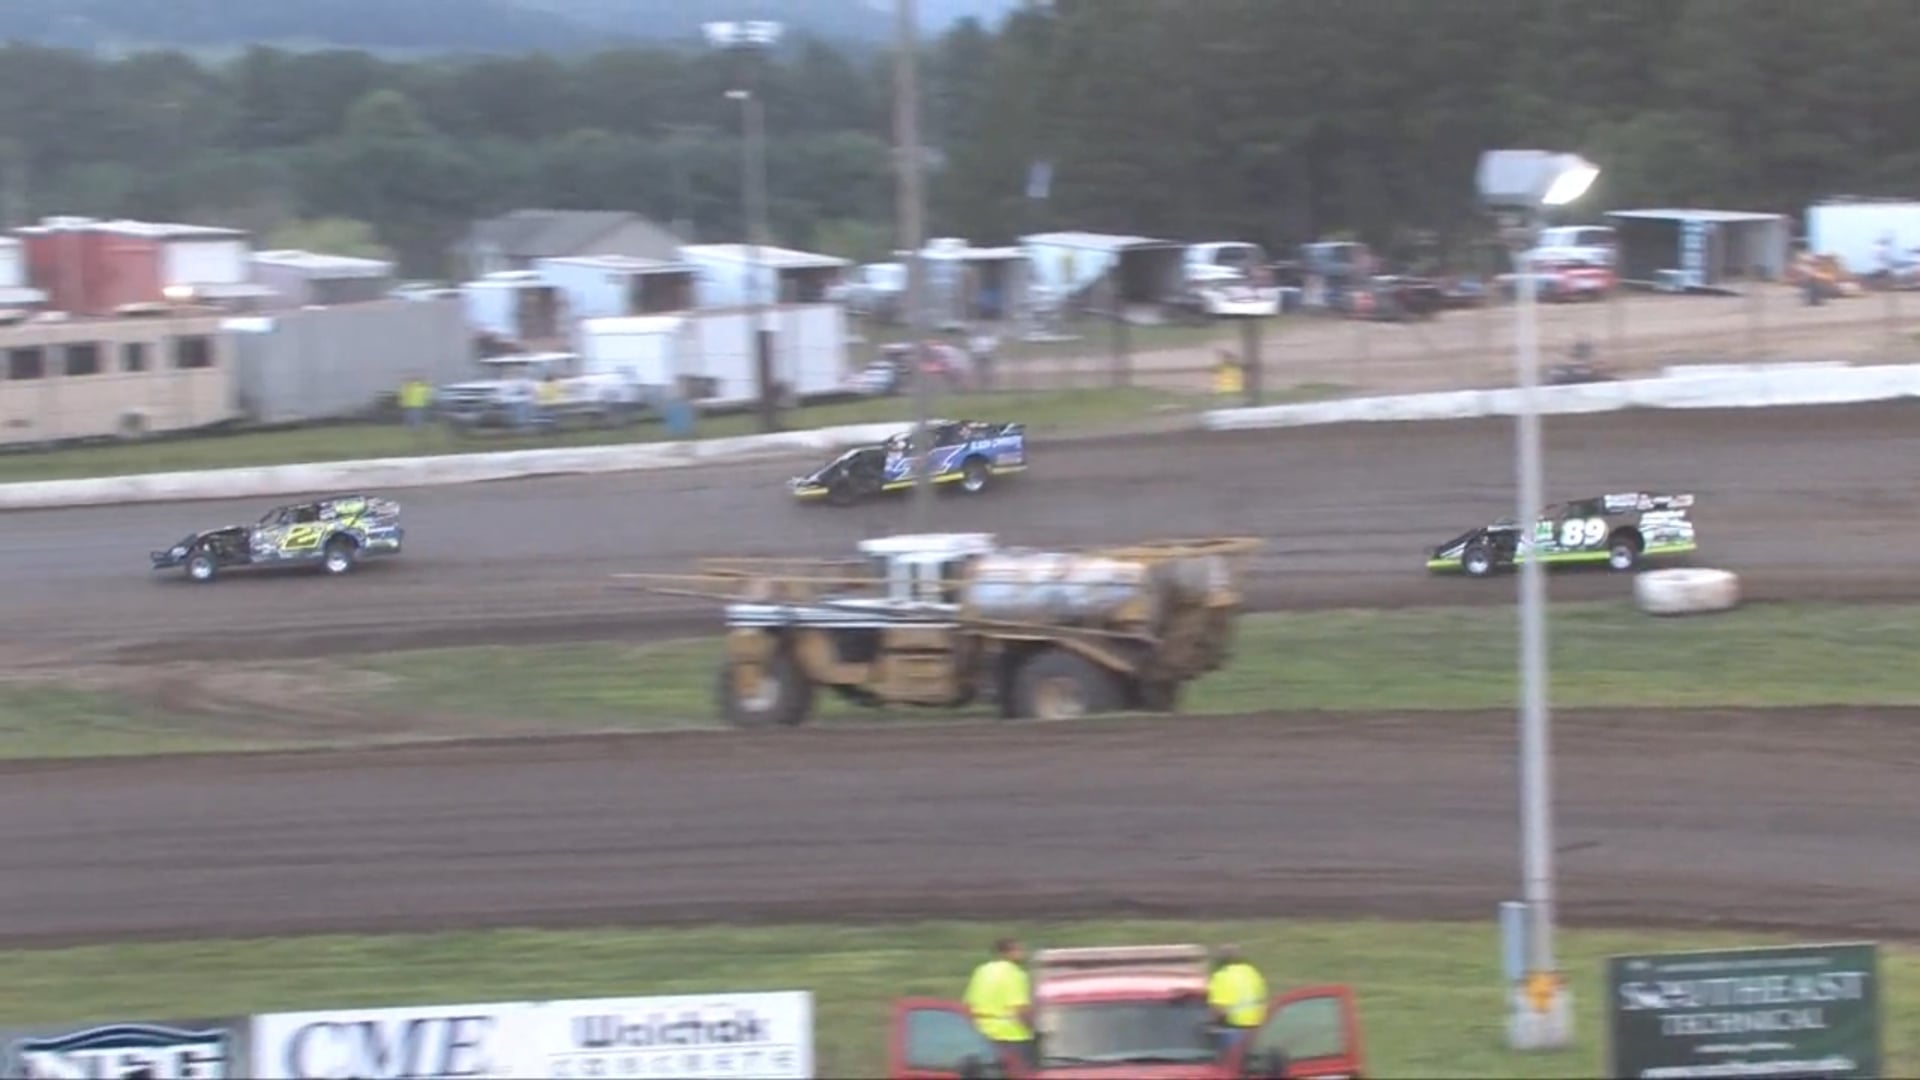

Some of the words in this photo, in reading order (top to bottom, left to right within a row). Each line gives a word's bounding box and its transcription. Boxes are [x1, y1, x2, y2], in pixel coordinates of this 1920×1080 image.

[1559, 517, 1608, 547] 89
[1659, 1007, 1827, 1036] TECHNICAL
[285, 1015, 495, 1078] CME
